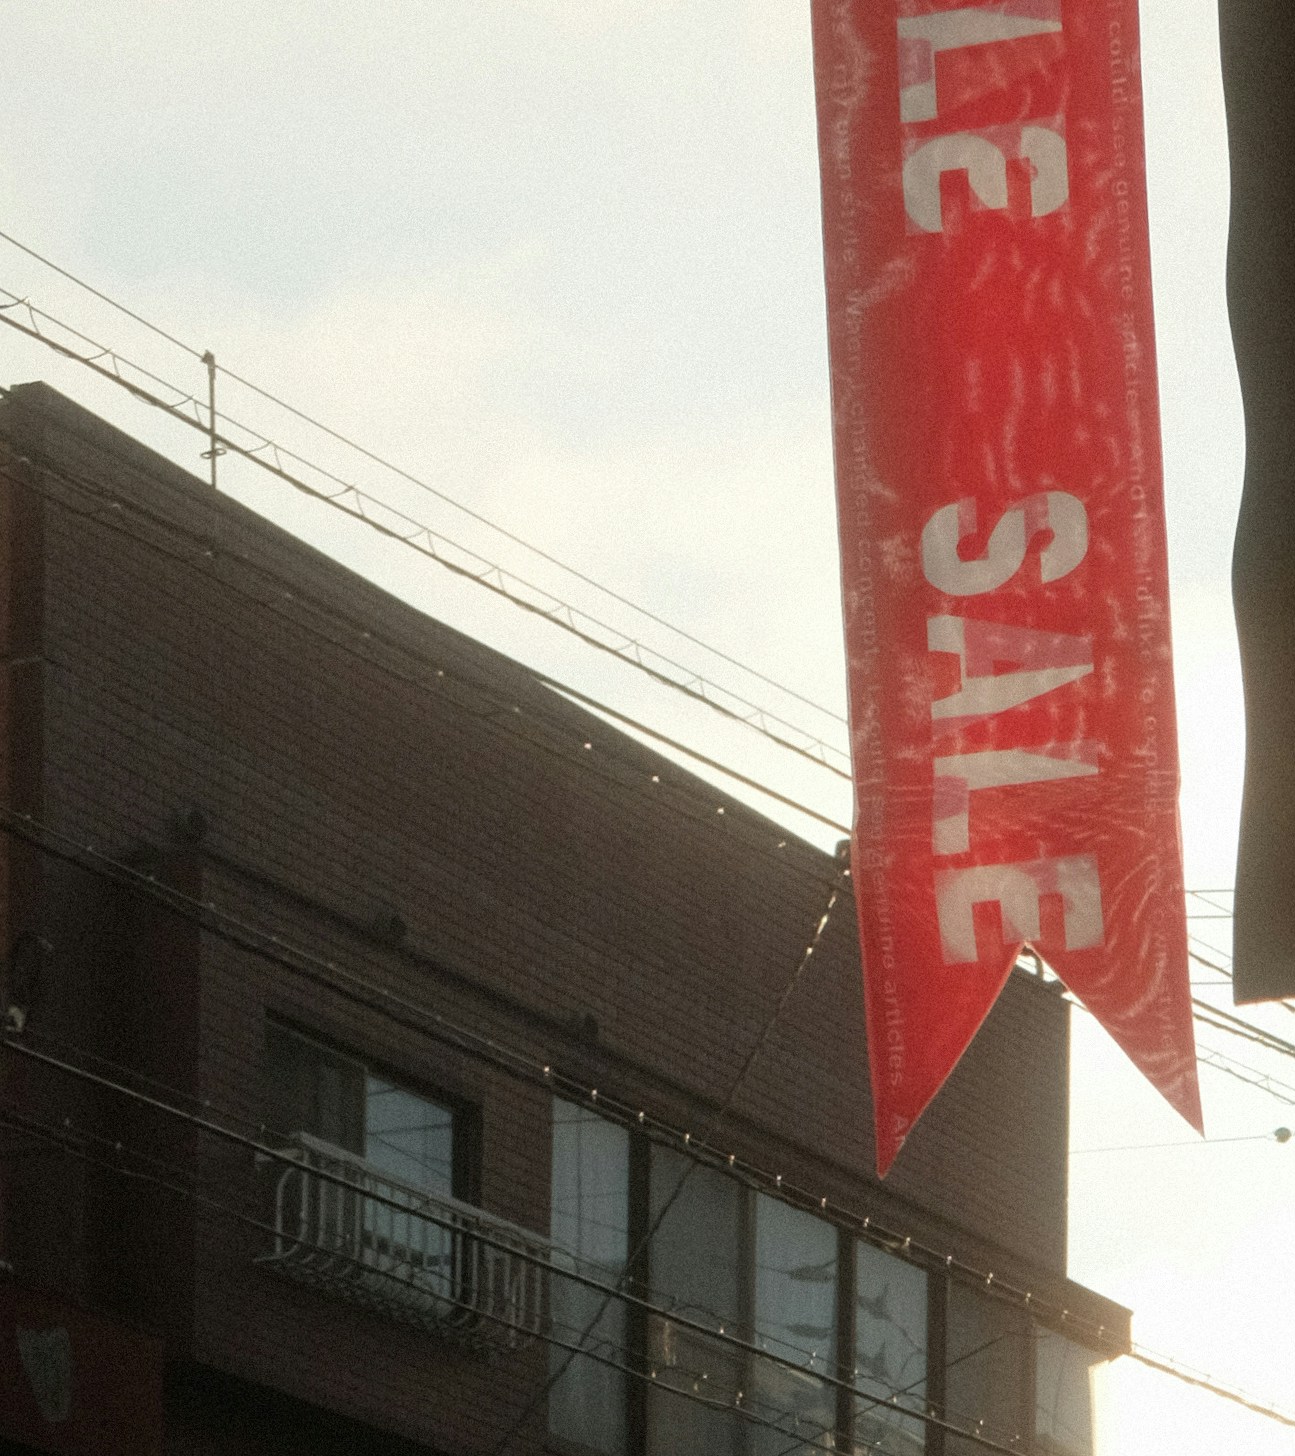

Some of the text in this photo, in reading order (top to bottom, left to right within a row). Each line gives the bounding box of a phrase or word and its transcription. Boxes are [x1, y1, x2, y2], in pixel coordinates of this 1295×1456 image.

[1109, 20, 1128, 104] could
[1111, 115, 1127, 167] see
[1111, 179, 1135, 300] genuine
[850, 402, 873, 527] changed
[864, 848, 897, 969] genuine
[918, 489, 1103, 964] SALE
